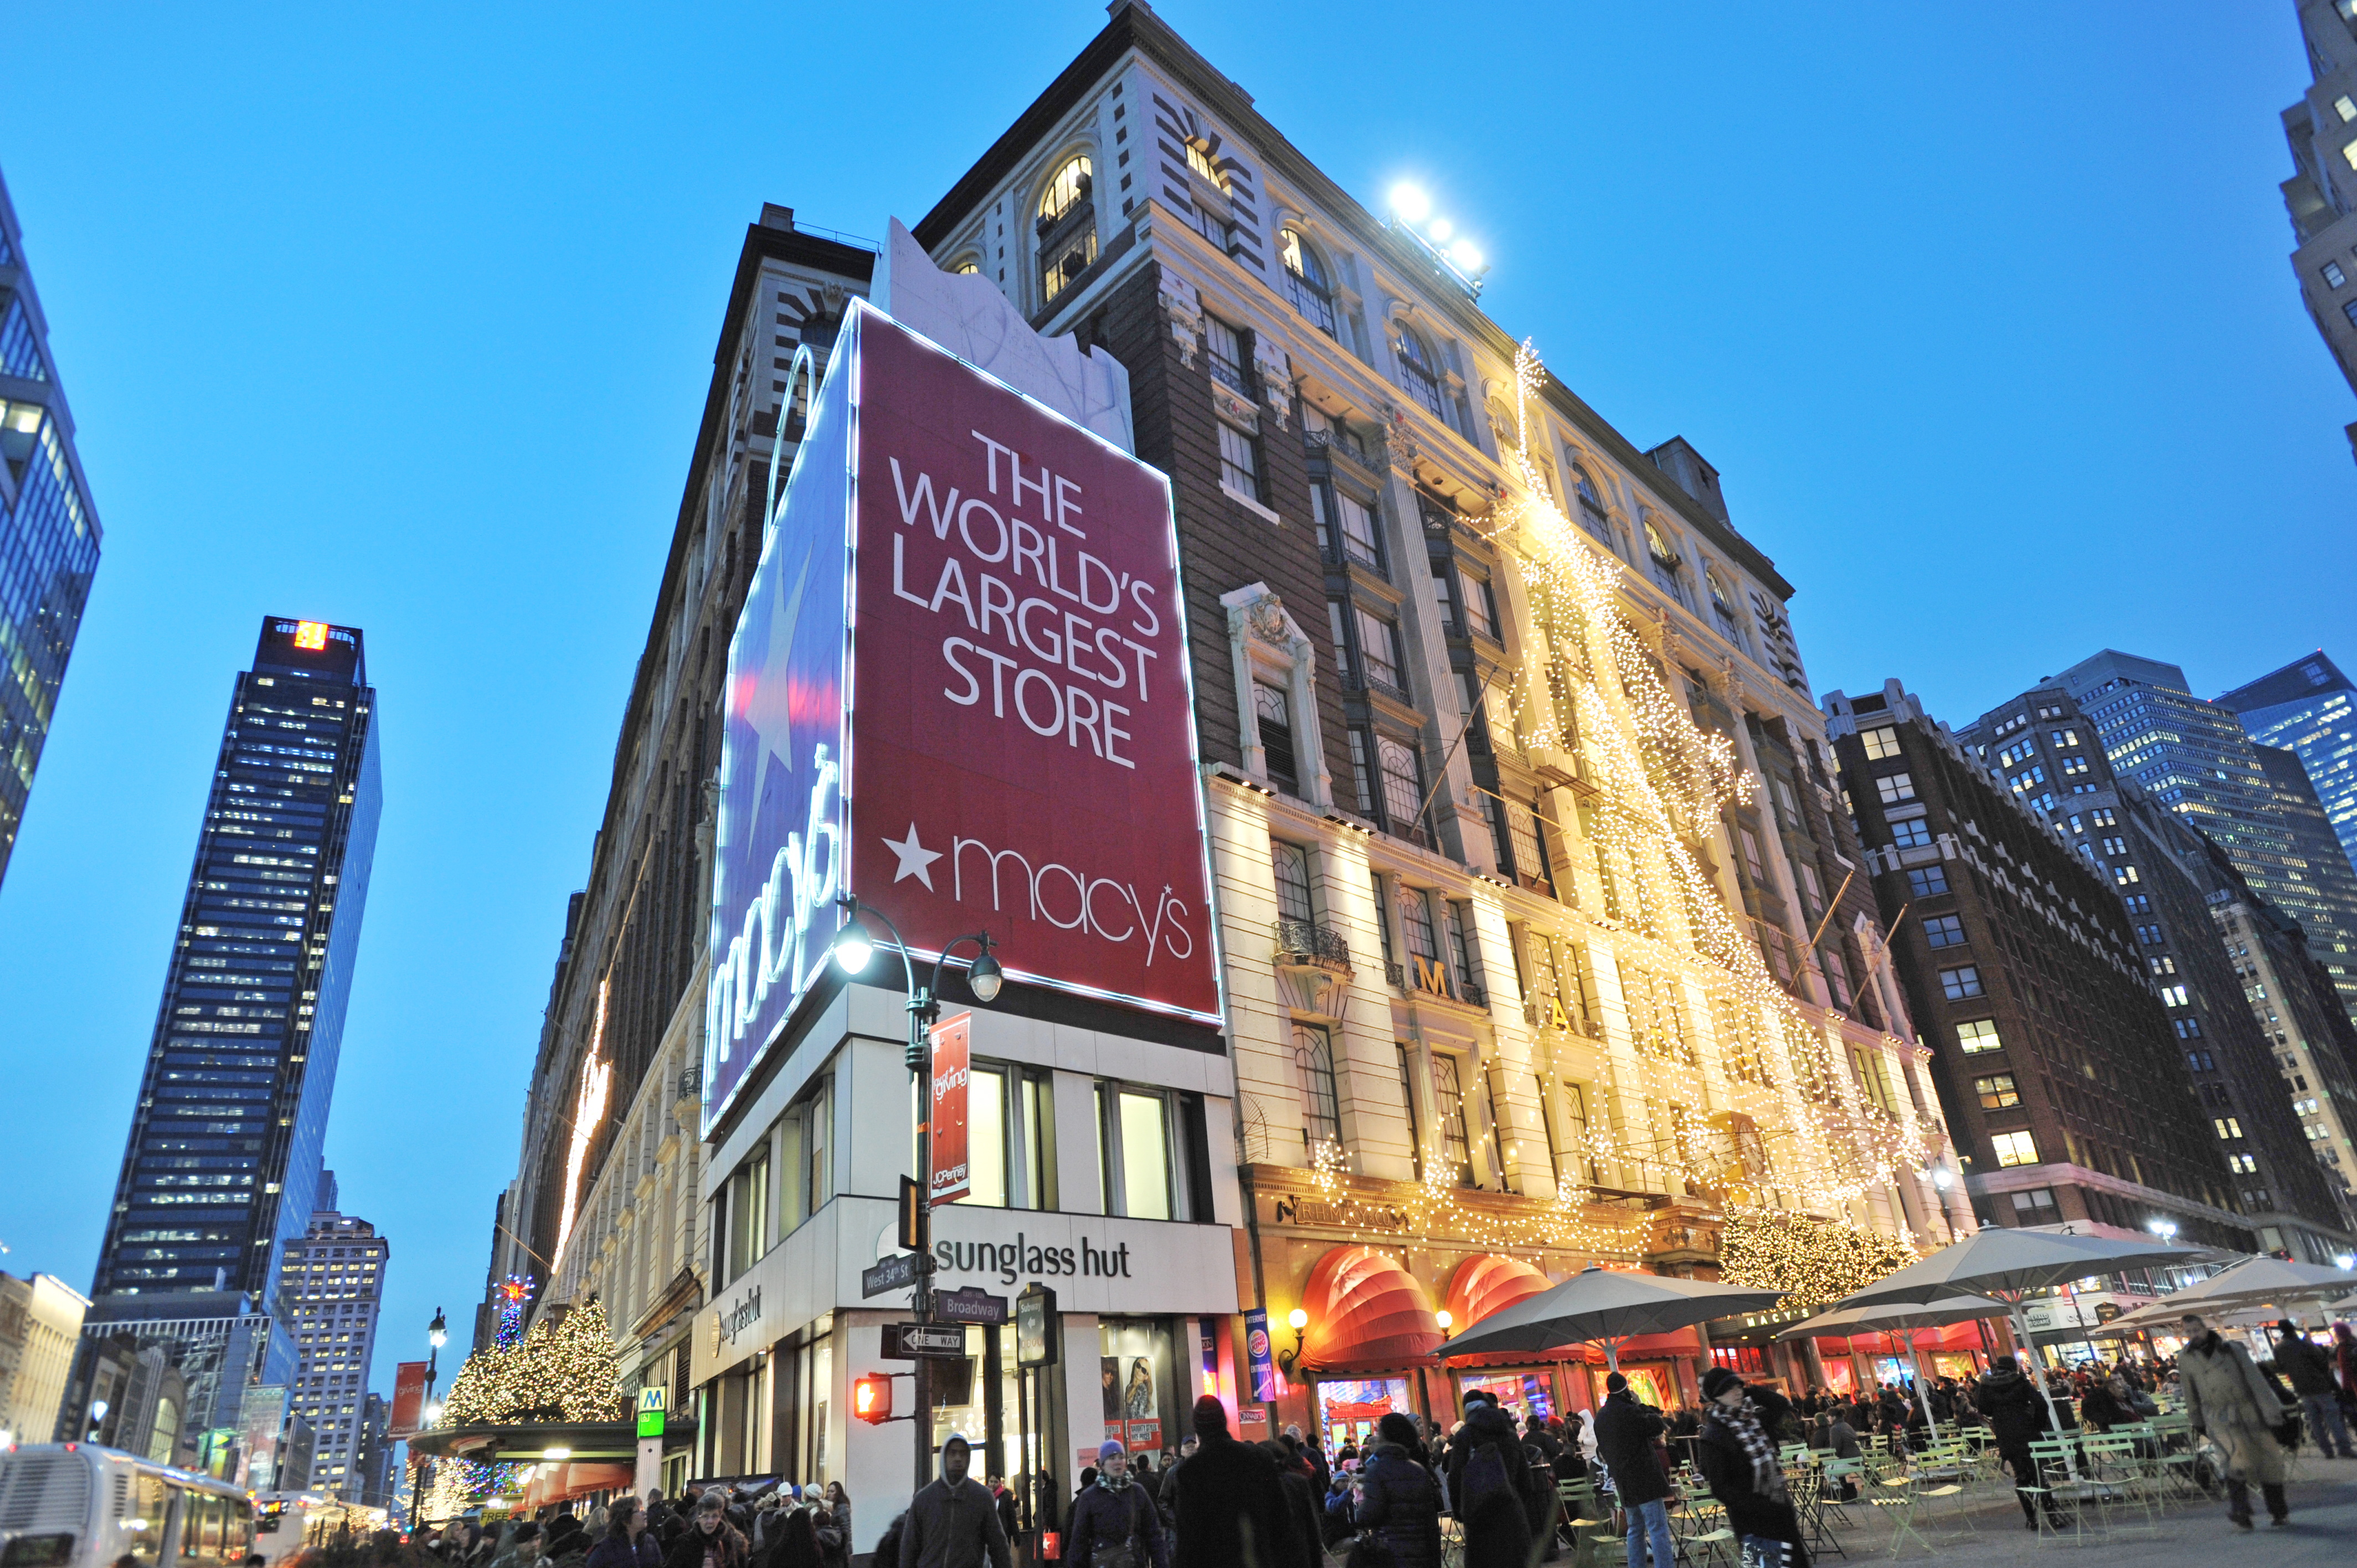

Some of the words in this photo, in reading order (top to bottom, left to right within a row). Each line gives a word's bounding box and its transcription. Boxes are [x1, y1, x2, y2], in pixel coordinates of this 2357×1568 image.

[971, 429, 1085, 539] THE
[889, 456, 1160, 637] WORLD'S
[893, 532, 1157, 703] LARGEST
[943, 636, 1135, 769] STORE
[935, 1066, 967, 1101] giving
[933, 1165, 966, 1185] JCPenney
[936, 1232, 1076, 1285] sunglass
[1082, 1237, 1131, 1277] hut
[867, 1272, 884, 1289] West
[886, 1266, 899, 1284] 34th
[901, 1264, 908, 1278] St
[947, 1298, 999, 1320] Broadway
[1021, 1302, 1041, 1313] Subway
[2067, 1312, 2097, 1322] CONW
[1246, 1314, 1266, 1324] INTERNET
[1746, 1308, 1809, 1327] MACY'S
[912, 1335, 929, 1345] ONE
[940, 1336, 958, 1347] WAY
[1251, 1334, 1264, 1345] BURGER
[1252, 1338, 1266, 1352] KING
[1250, 1363, 1271, 1373] ENTRANCE
[398, 1384, 423, 1396] giving
[481, 1512, 509, 1521] FREE
